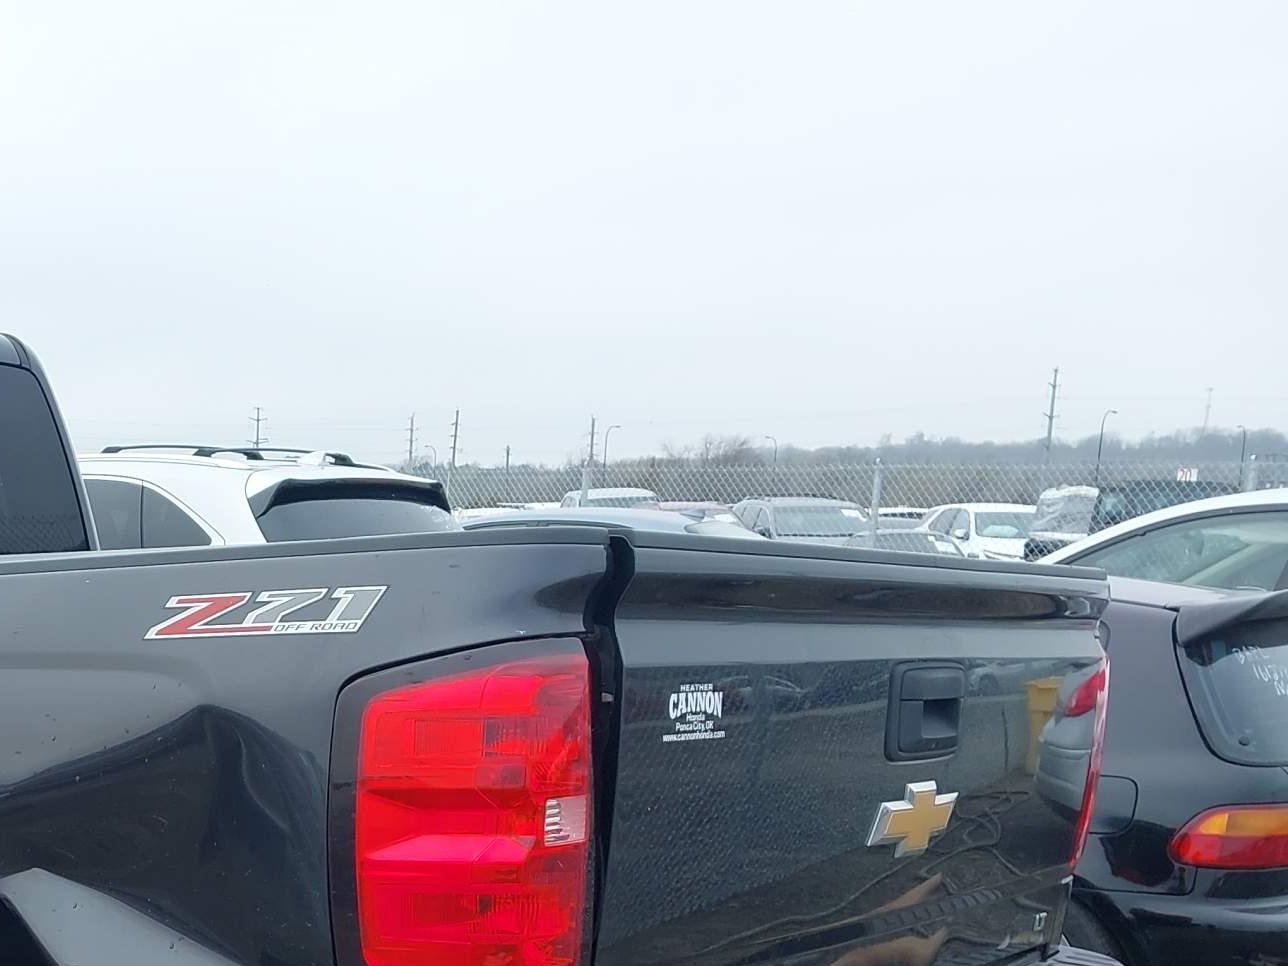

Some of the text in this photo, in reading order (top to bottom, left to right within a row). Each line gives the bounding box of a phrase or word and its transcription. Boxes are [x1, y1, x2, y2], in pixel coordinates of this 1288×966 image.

[143, 585, 388, 640] Z71
[274, 621, 358, 632] OFF ROAD
[680, 683, 713, 691] HEATHER
[669, 691, 723, 719] CANNON
[706, 720, 714, 729] OK
[1033, 912, 1048, 931] LT
